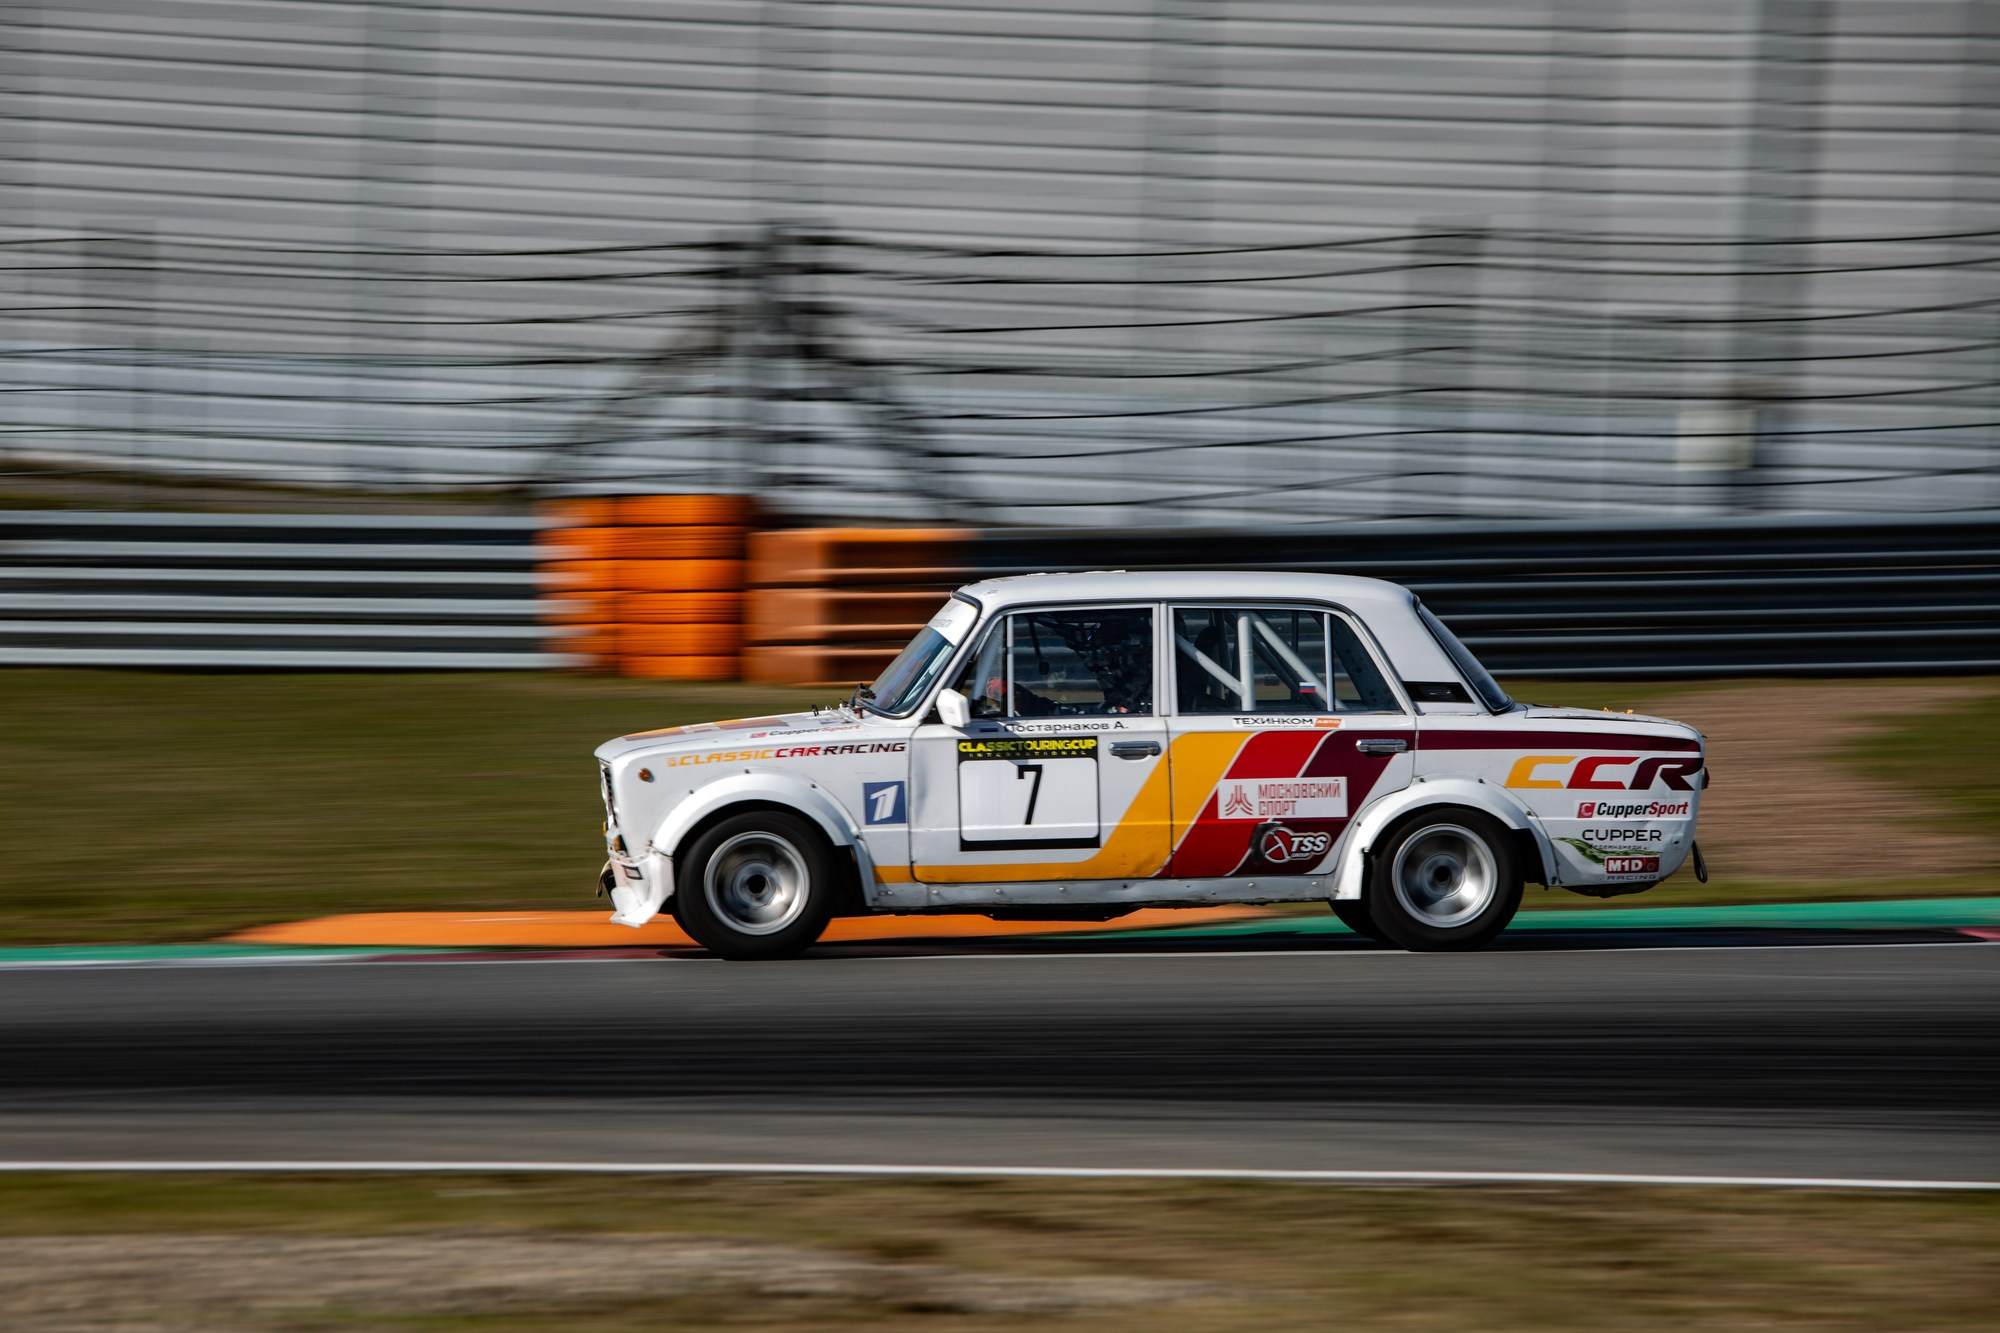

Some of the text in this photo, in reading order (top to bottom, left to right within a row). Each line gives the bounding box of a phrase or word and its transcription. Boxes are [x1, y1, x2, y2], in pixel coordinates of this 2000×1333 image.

[1004, 721, 1109, 734] Постарнаков
[1233, 717, 1313, 725] ТЕХИНКОМ
[1504, 755, 1704, 791] CCR
[1017, 764, 1043, 825] 7
[1257, 779, 1341, 799] МОСКОВСКИЙ
[1258, 800, 1297, 816] СПОРТ
[1597, 801, 1688, 818] CupperSport
[1582, 829, 1662, 841] CUPPER
[1290, 836, 1327, 852] TSS
[1608, 859, 1643, 872] M1D
